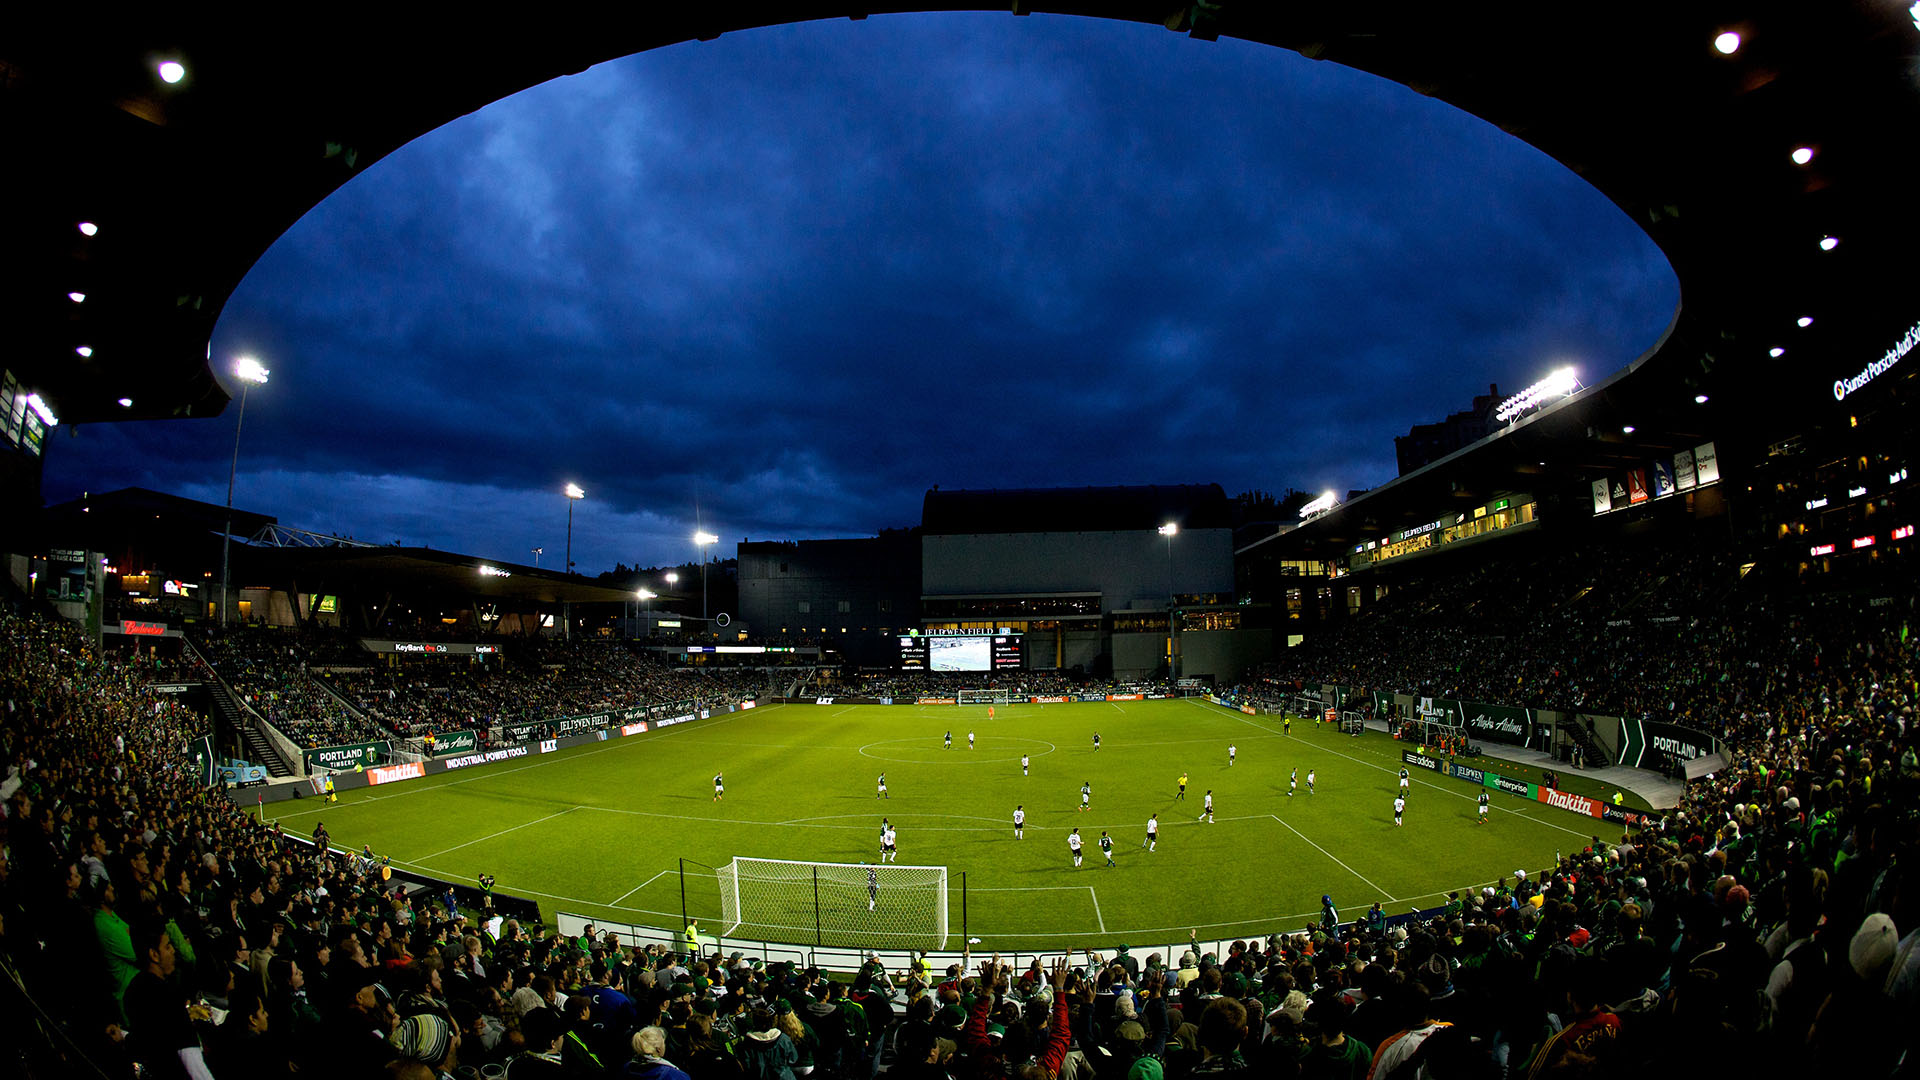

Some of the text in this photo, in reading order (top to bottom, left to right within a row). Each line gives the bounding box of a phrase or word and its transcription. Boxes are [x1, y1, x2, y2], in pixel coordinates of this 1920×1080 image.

[1844, 368, 1871, 395] Sunset
[1868, 349, 1899, 379] Porsche
[1895, 331, 1914, 359] Audi
[395, 643, 424, 653] KeyBank
[592, 714, 610, 726] FIELD
[1470, 714, 1523, 736] Alaska Airlines
[1653, 735, 1696, 760] PORTLAND
[320, 748, 364, 763] PORTLAND
[446, 746, 528, 769] INDUSTRIAL POWER TOOLS
[1417, 755, 1436, 769] adidas
[330, 760, 356, 769] TIMBERS
[1493, 778, 1528, 794] enterprise
[1609, 809, 1624, 820] pepsi
